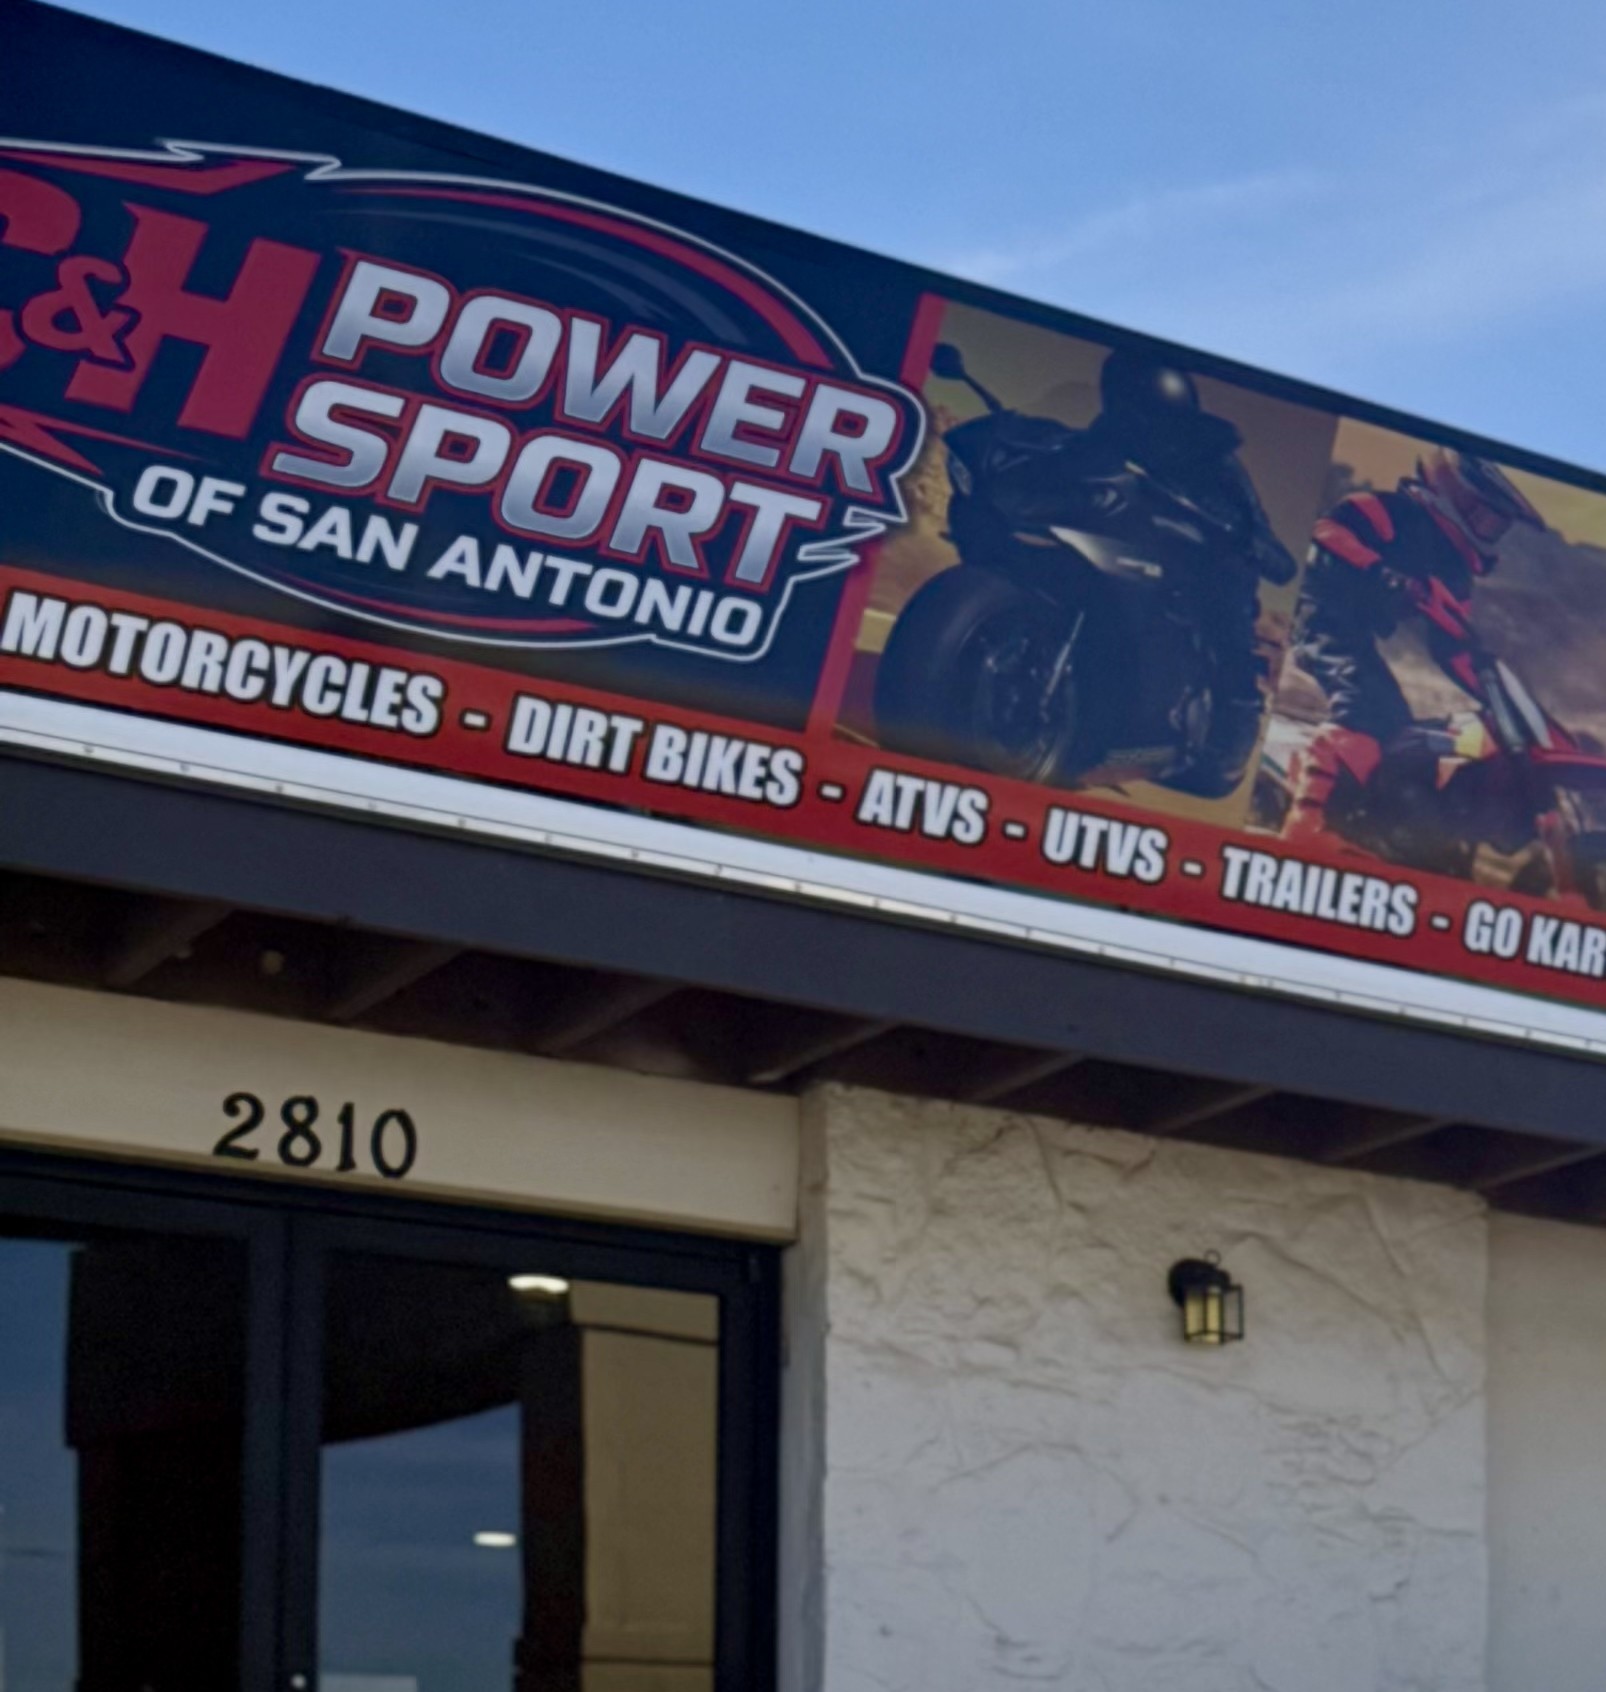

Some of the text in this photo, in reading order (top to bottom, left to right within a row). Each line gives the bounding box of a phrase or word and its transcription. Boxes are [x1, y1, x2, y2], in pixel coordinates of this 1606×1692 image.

[320, 258, 898, 494] POWER
[132, 464, 764, 647] OF SAN ANTONIO
[271, 379, 822, 586] SPORT
[0, 591, 445, 735] MOTORCYCLES
[507, 695, 645, 773] DIRT
[644, 723, 804, 806] BIKES
[857, 768, 989, 844] ATVS
[1043, 807, 1169, 883] UTVS
[1222, 845, 1418, 936] TRAILERS
[1464, 901, 1524, 958] GO
[212, 1091, 418, 1179] 2810
